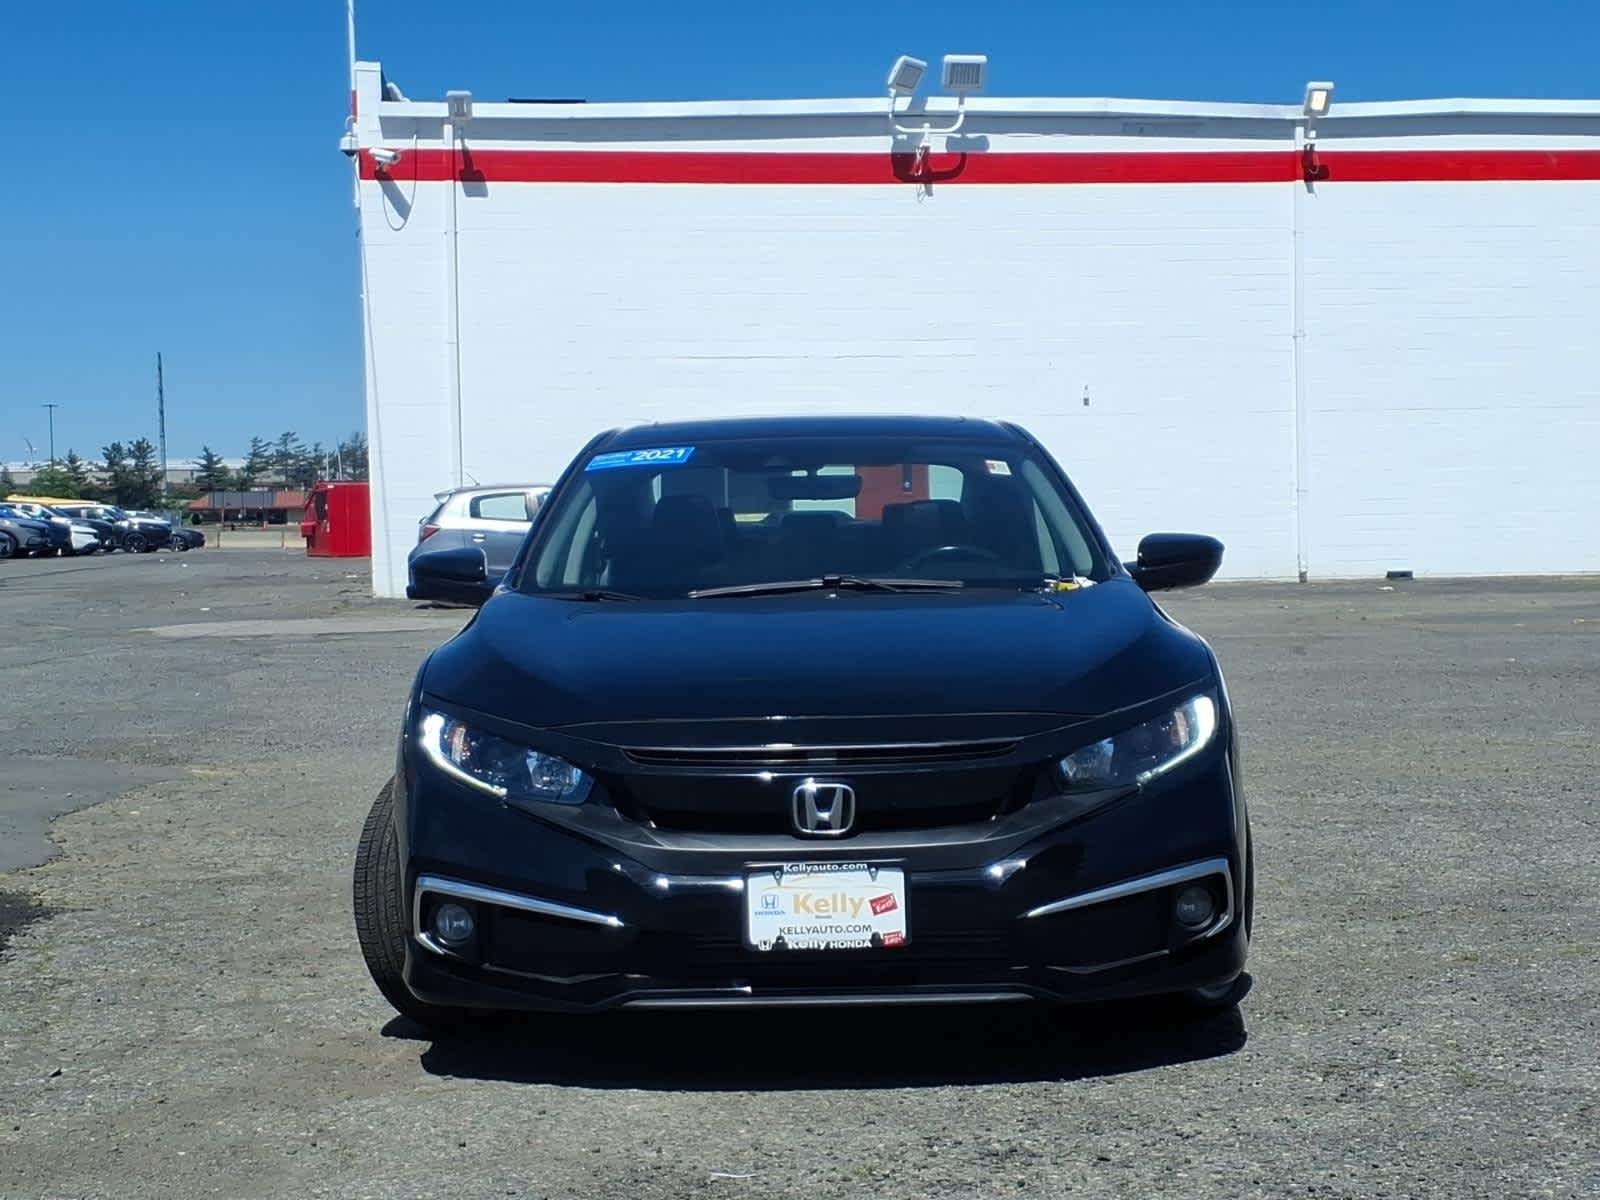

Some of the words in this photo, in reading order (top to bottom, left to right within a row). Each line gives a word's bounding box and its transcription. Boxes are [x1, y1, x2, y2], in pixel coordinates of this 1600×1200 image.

[631, 448, 685, 461] 2021
[783, 863, 867, 873] Kellyauto.com
[793, 892, 865, 919] Kelly
[779, 924, 872, 936] KELLYAUTO.COM
[787, 940, 827, 949] Kelly
[830, 940, 872, 948] HONDA
